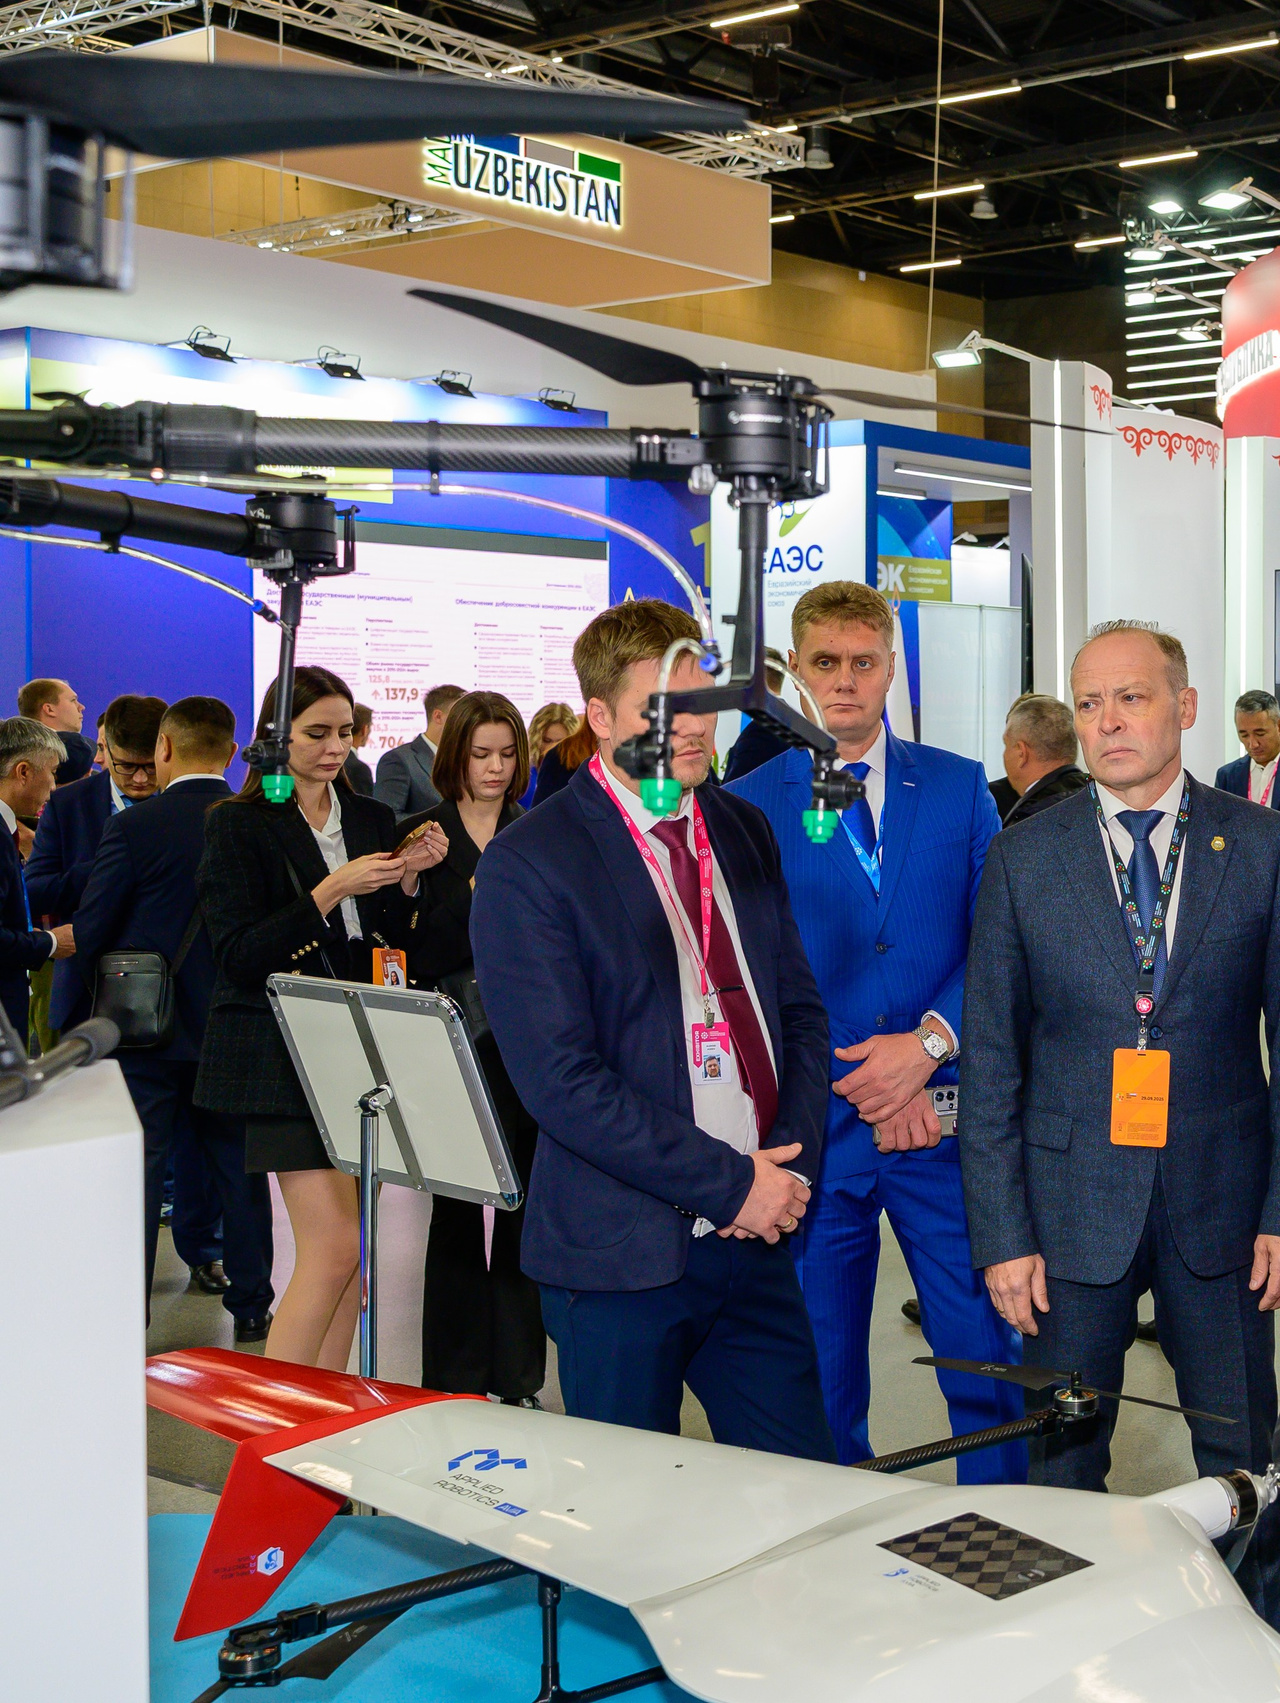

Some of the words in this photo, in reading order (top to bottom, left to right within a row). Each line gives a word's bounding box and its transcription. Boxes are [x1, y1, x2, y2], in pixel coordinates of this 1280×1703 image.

[453, 143, 622, 226] UZBEKISTAN
[385, 687, 419, 703] 137,9
[433, 1480, 500, 1507] ROBOTICS
[449, 1474, 504, 1495] APPLIED
